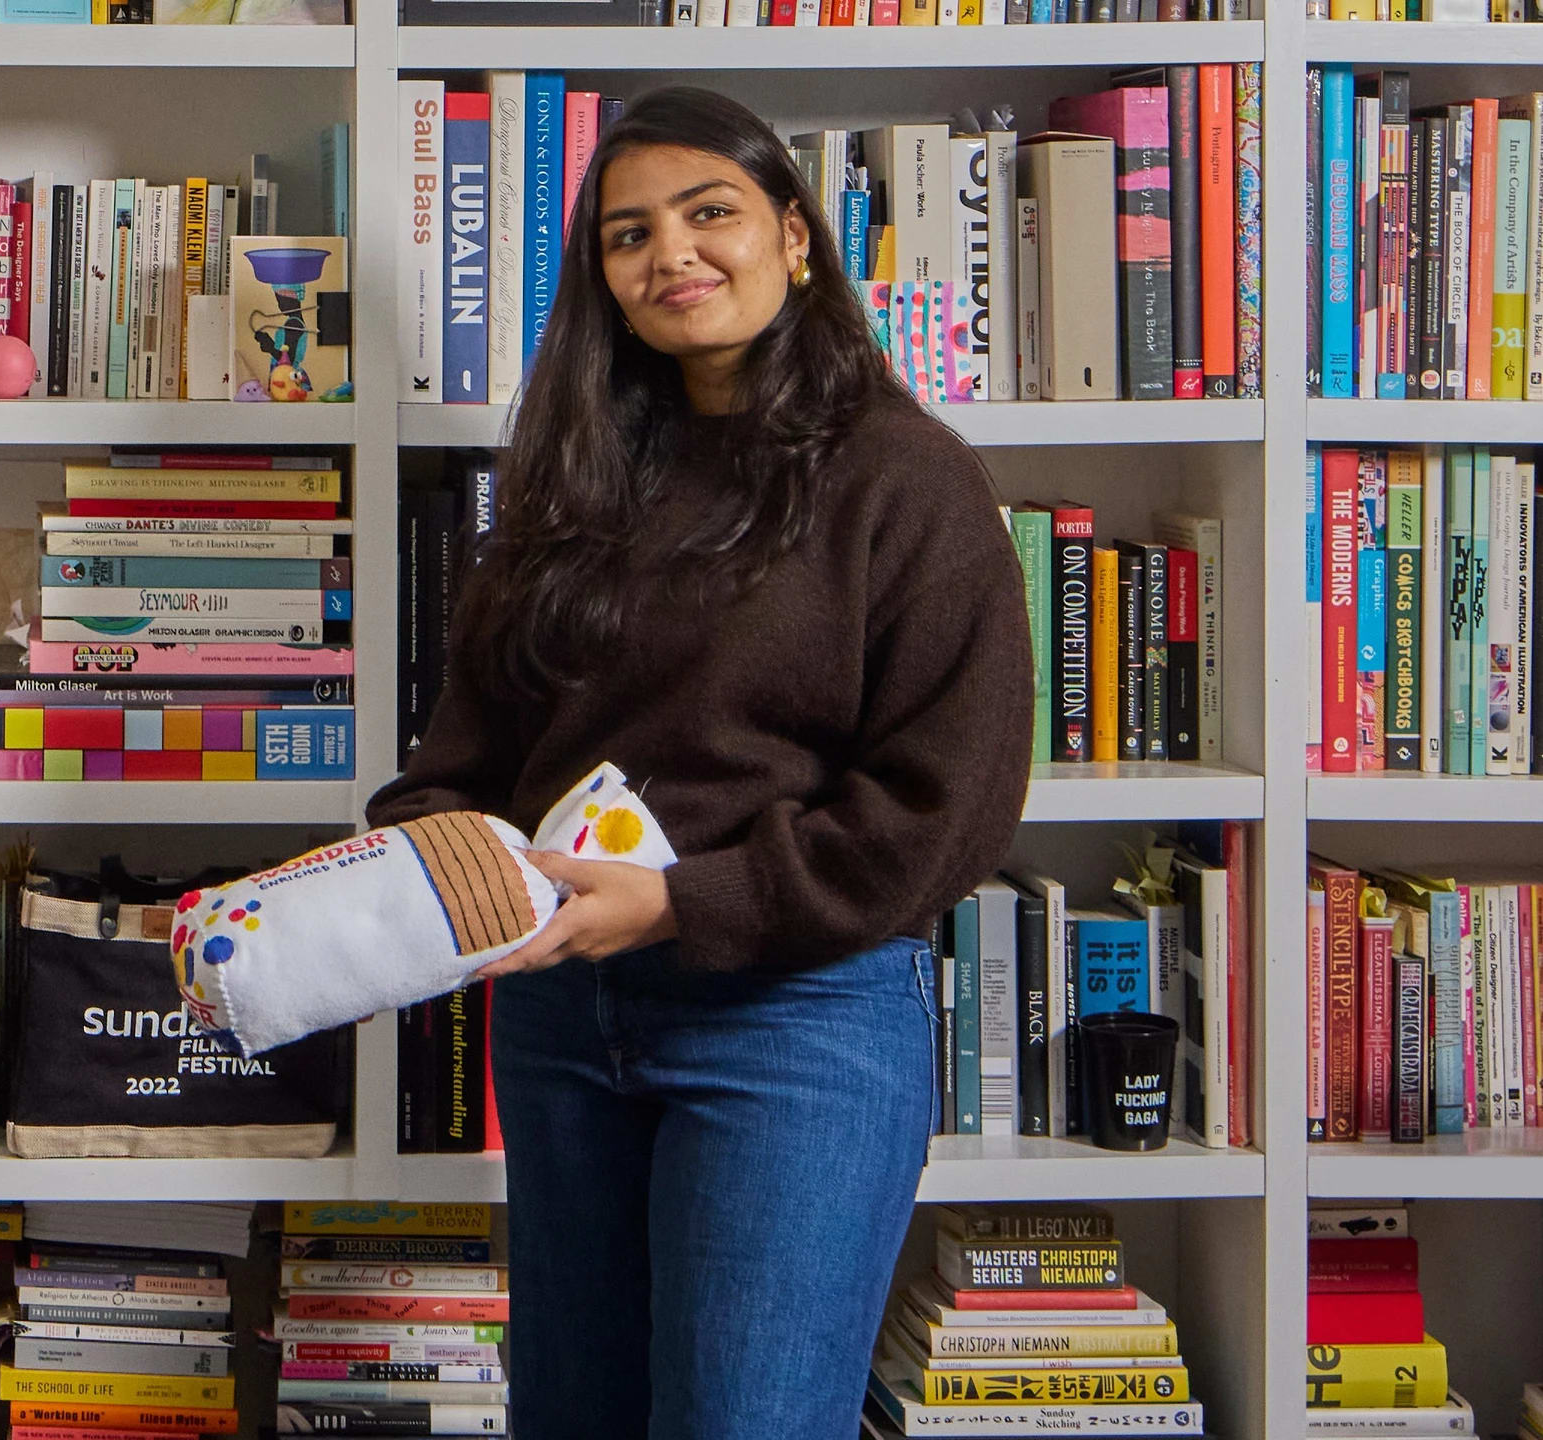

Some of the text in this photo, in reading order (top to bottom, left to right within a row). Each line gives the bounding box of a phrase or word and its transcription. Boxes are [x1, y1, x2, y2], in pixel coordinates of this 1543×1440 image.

[413, 99, 438, 245] Saul Bass
[450, 164, 484, 324] LUBALIN
[1057, 521, 1093, 534] PORTER
[1330, 488, 1353, 607] THE MODERNS
[1150, 554, 1164, 641] GENOME
[1063, 545, 1087, 719] ON COMPETITION
[15, 679, 99, 692] Milton Glaser
[104, 690, 174, 701] Art is Work
[265, 724, 289, 764] SETH
[292, 724, 311, 764] GODIN
[249, 832, 389, 884] WONDER
[258, 848, 387, 890] ENRICHED BREAD
[1028, 991, 1044, 1045] BLACK
[178, 1056, 276, 1076] FESTIVAL
[125, 1077, 181, 1094] 2022
[1125, 1074, 1159, 1090] LADY
[1115, 1091, 1166, 1107] FUCKING
[1124, 1111, 1159, 1125] GAGA
[973, 1250, 1037, 1266] MASTERS
[1040, 1250, 1118, 1266] CHRISTOPH
[973, 1268, 1023, 1284] SERIES
[1041, 1268, 1103, 1284] NIEMANN
